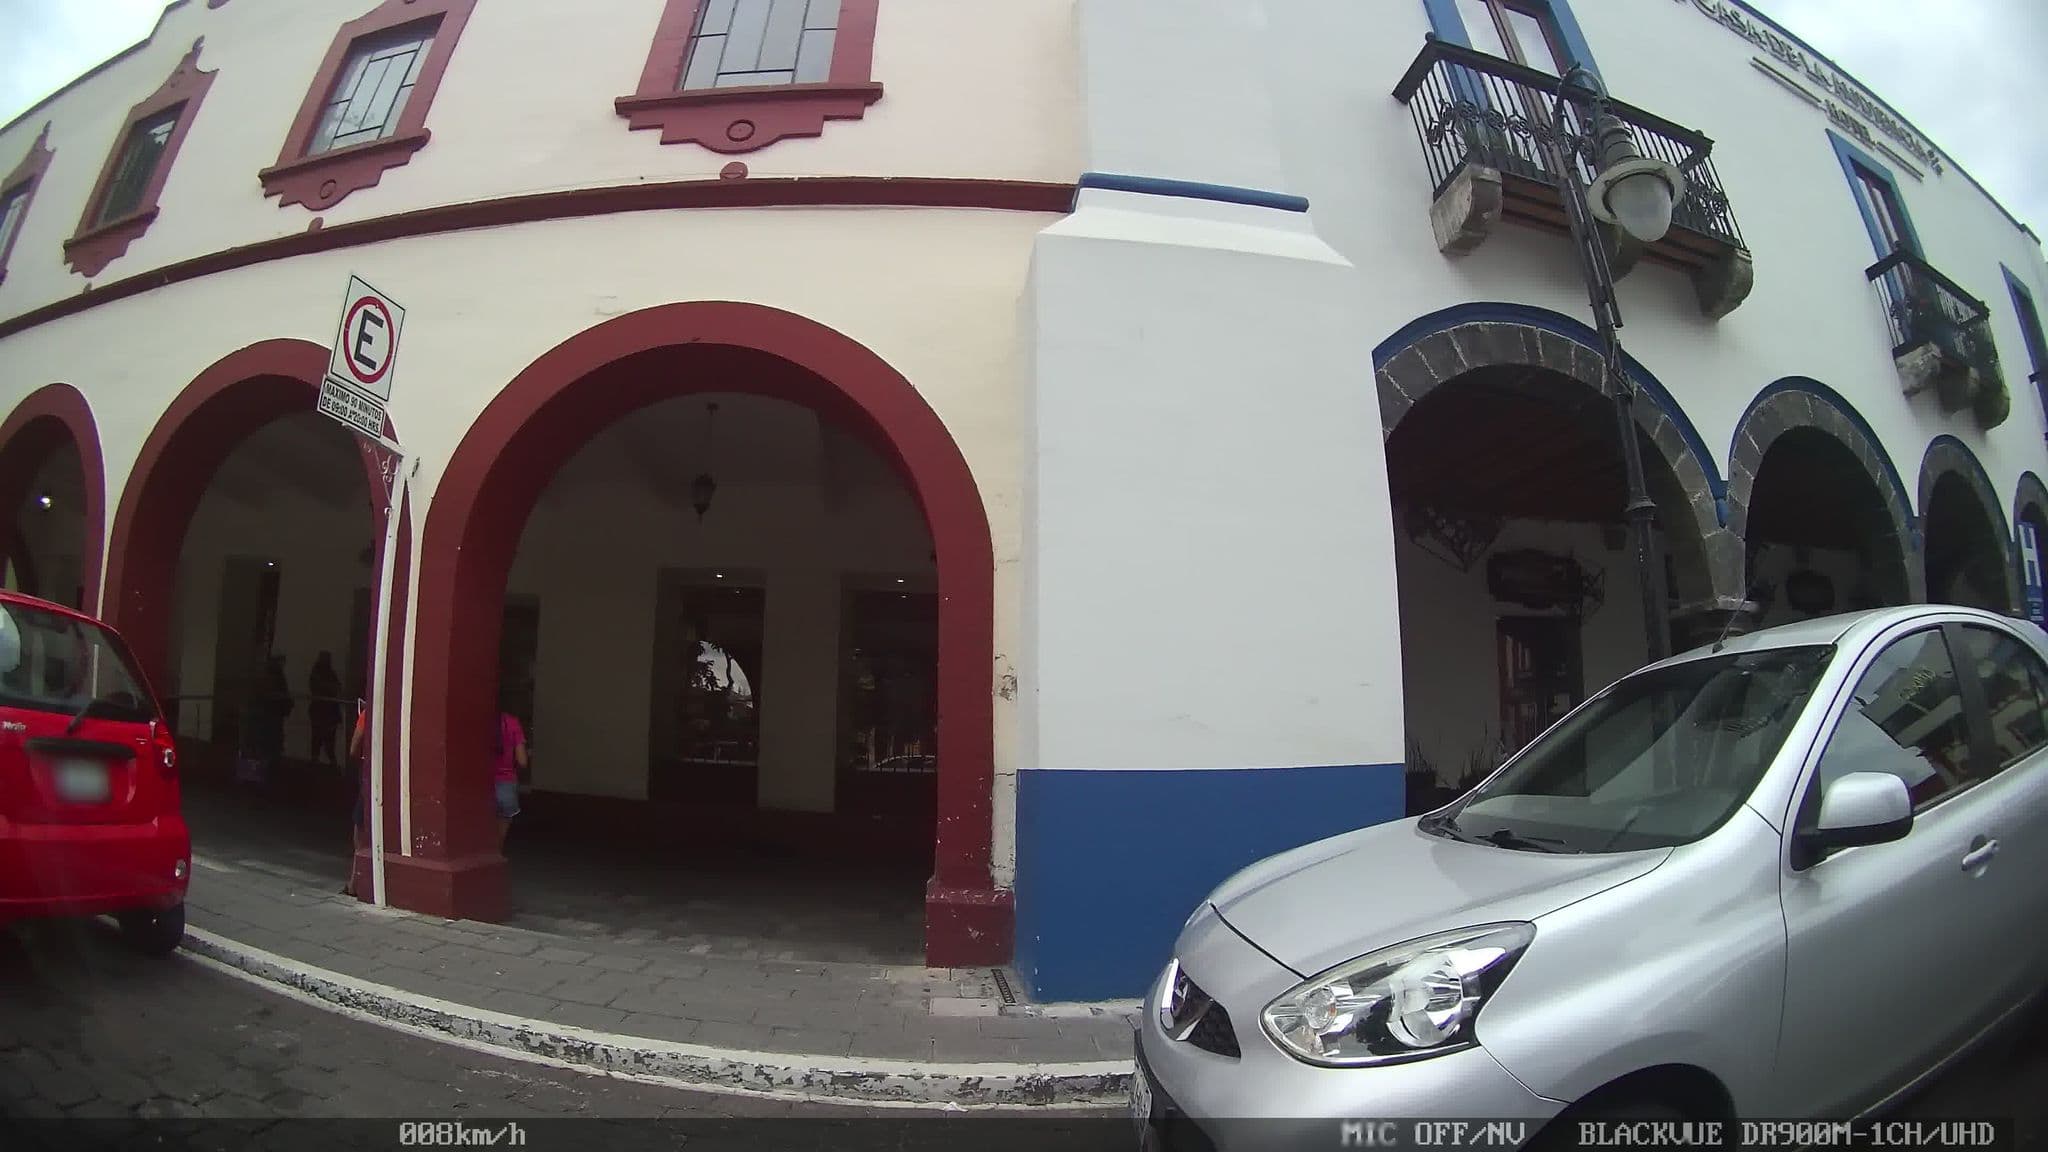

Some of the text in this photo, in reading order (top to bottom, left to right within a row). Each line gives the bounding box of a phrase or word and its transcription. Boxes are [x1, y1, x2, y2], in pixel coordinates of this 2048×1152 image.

[354, 309, 384, 371] E
[321, 396, 332, 409] DE
[357, 400, 382, 421] MINUTOS
